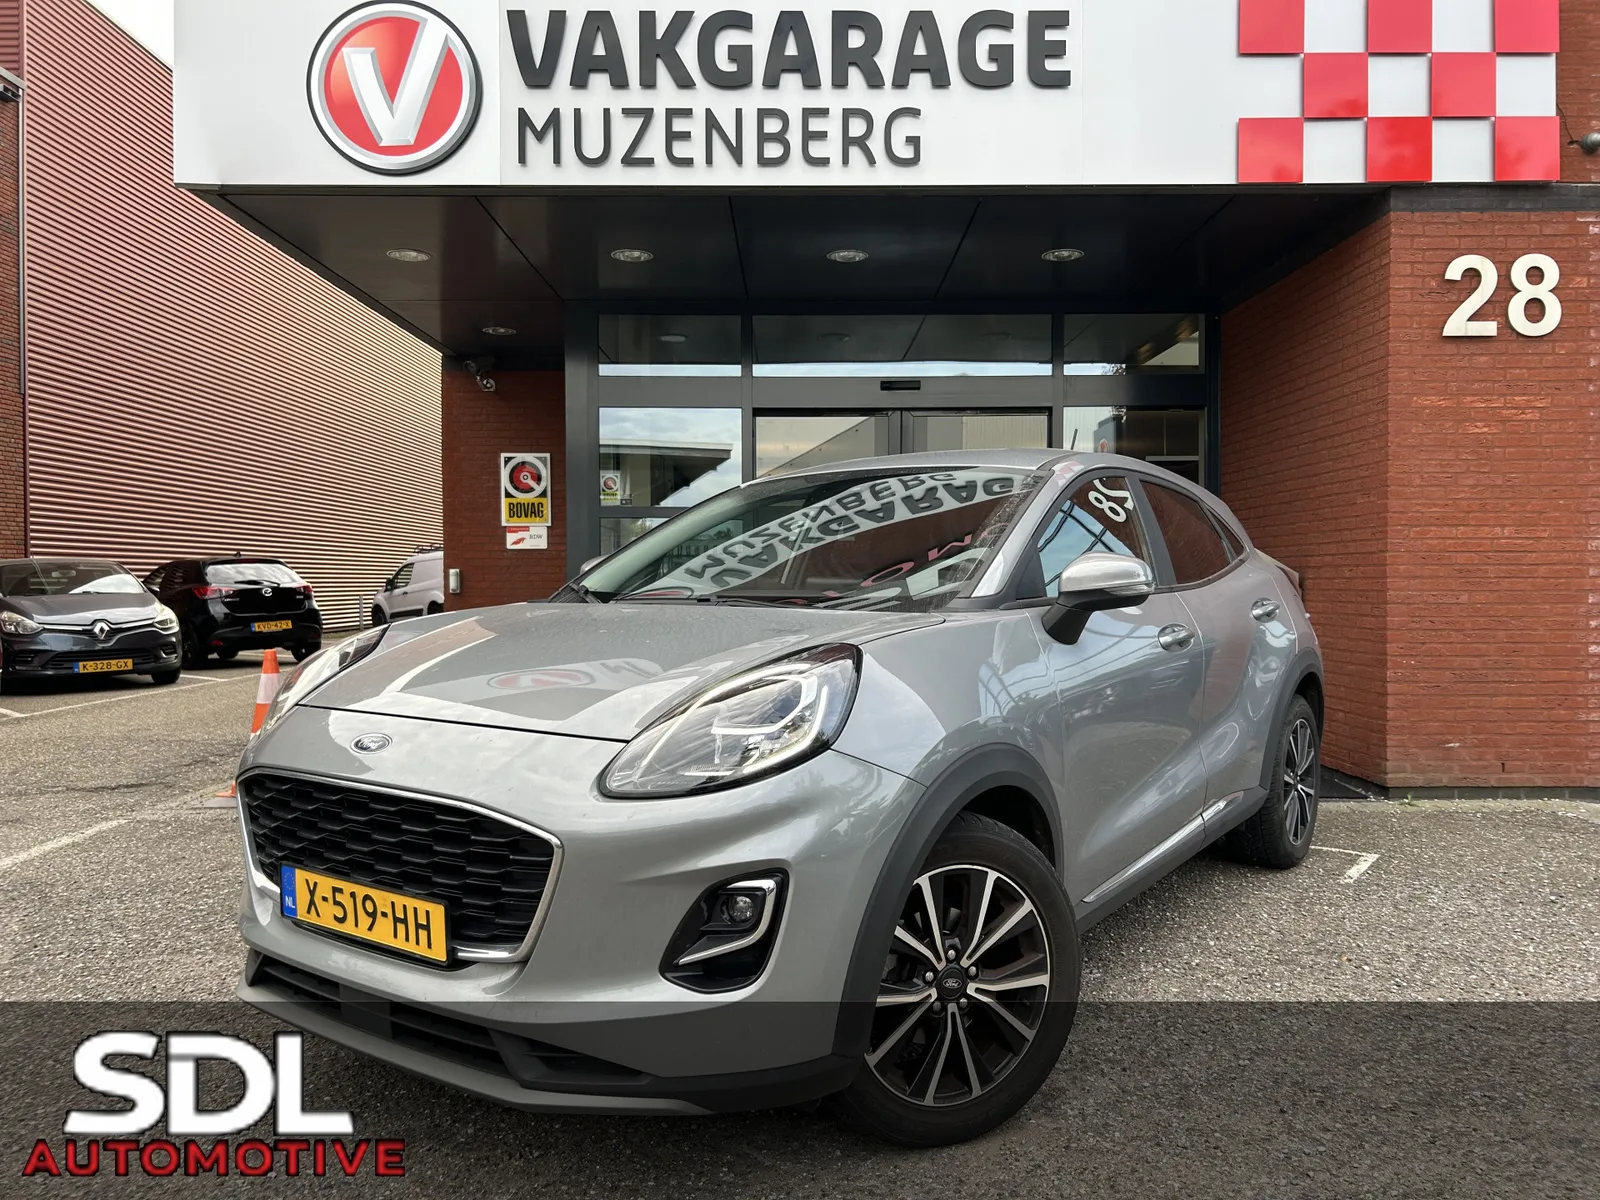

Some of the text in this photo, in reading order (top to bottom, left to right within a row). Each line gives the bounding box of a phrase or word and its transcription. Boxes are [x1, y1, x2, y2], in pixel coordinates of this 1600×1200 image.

[507, 9, 1071, 89] VAKGARAGE
[517, 106, 921, 166] MUZENBERG
[1442, 253, 1562, 337] 28
[508, 502, 544, 518] BOVAG
[82, 660, 129, 672] K-328-GX
[285, 878, 432, 949] NL X-519-HH
